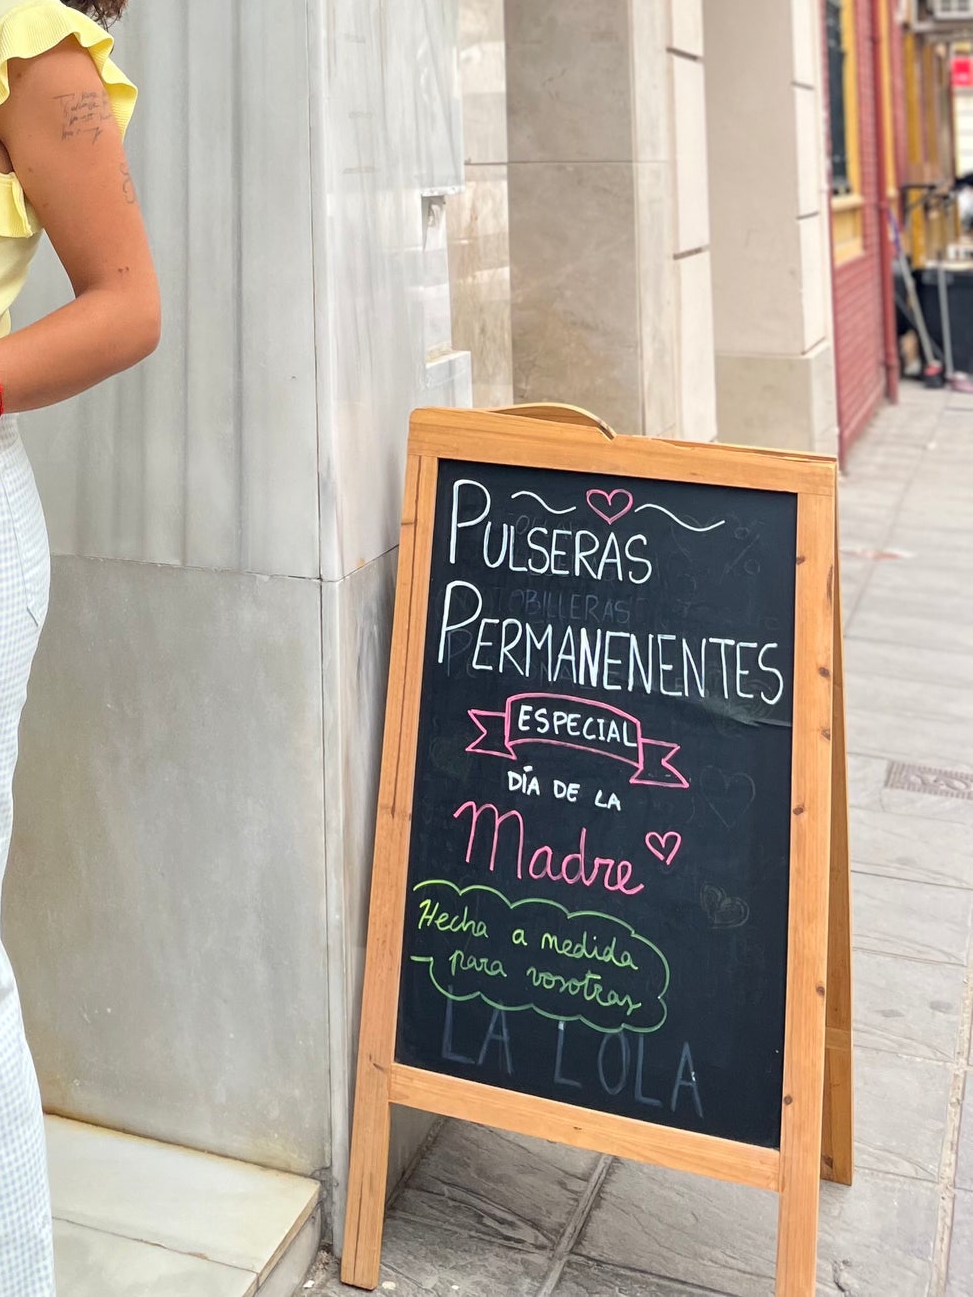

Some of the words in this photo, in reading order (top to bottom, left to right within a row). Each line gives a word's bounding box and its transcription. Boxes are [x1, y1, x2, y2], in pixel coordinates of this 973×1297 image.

[518, 705, 638, 747] ESPECIAL
[507, 765, 540, 796] DÍA
[553, 780, 580, 802] DE
[595, 790, 621, 811] LA
[453, 800, 644, 895] Madre
[418, 899, 489, 938] Hecha
[512, 928, 528, 946] a
[541, 931, 638, 970] medida
[449, 950, 507, 977] para
[527, 966, 642, 1015] vosotras
[442, 985, 514, 1076] LA
[554, 1018, 704, 1118] LOLA
